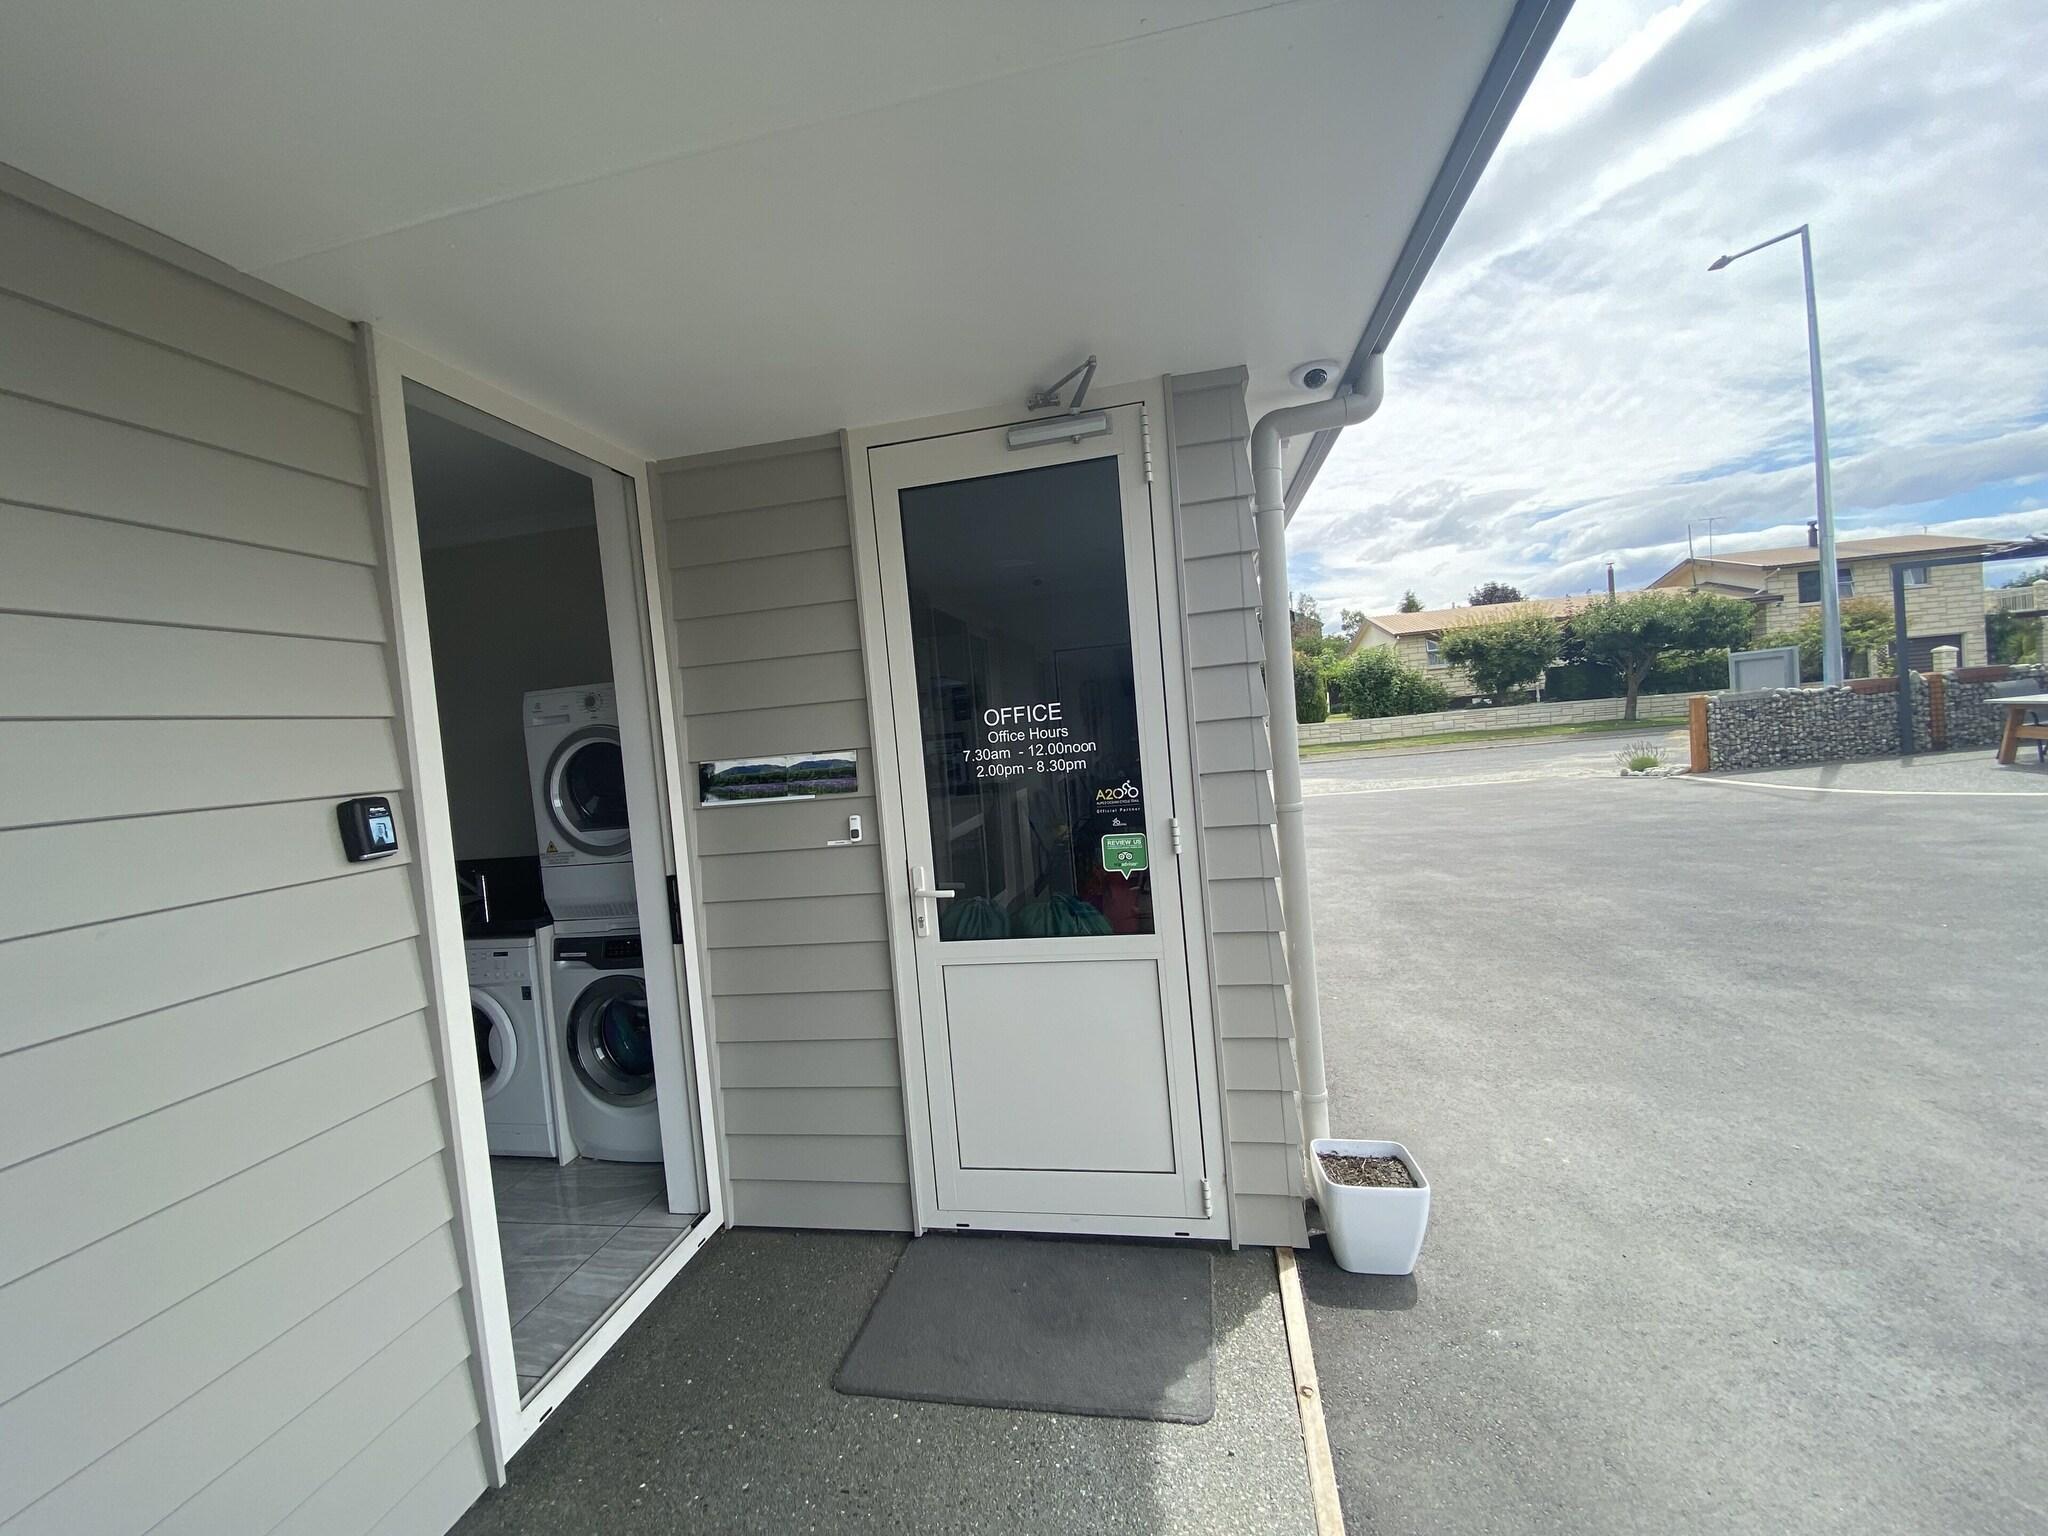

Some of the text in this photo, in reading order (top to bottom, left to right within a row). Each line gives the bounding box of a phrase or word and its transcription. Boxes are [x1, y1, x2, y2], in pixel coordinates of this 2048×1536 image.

[984, 703, 1062, 726] OFFICE
[988, 727, 1069, 743] Office Hours
[963, 749, 1011, 762] 7.30am
[1028, 742, 1096, 757] 12.00noon
[976, 764, 1024, 778] 2.00pm
[1036, 759, 1087, 773] 8.30pm
